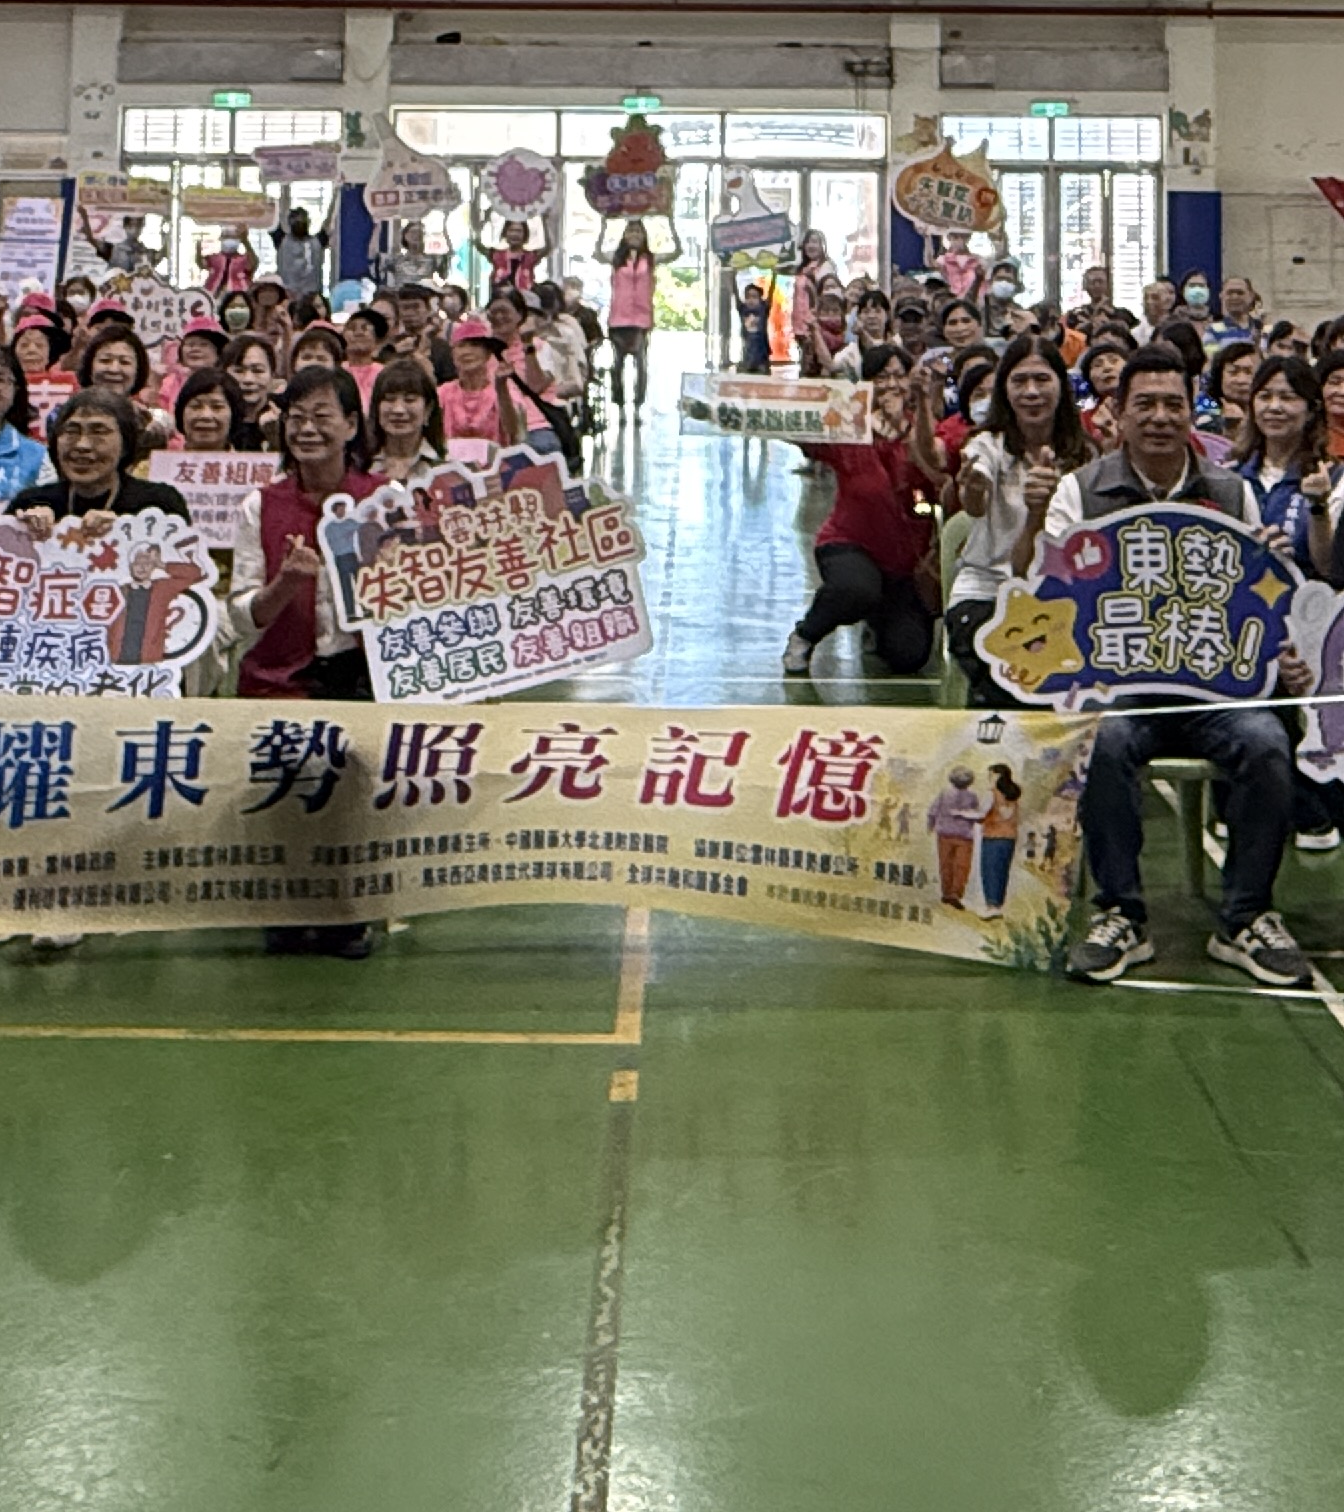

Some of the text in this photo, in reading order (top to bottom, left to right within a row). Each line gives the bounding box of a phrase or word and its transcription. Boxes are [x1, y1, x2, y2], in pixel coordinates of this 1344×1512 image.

[174, 460, 274, 487] 友善組織
[359, 506, 637, 619] 失智友善社區
[1119, 520, 1243, 602] 東勢
